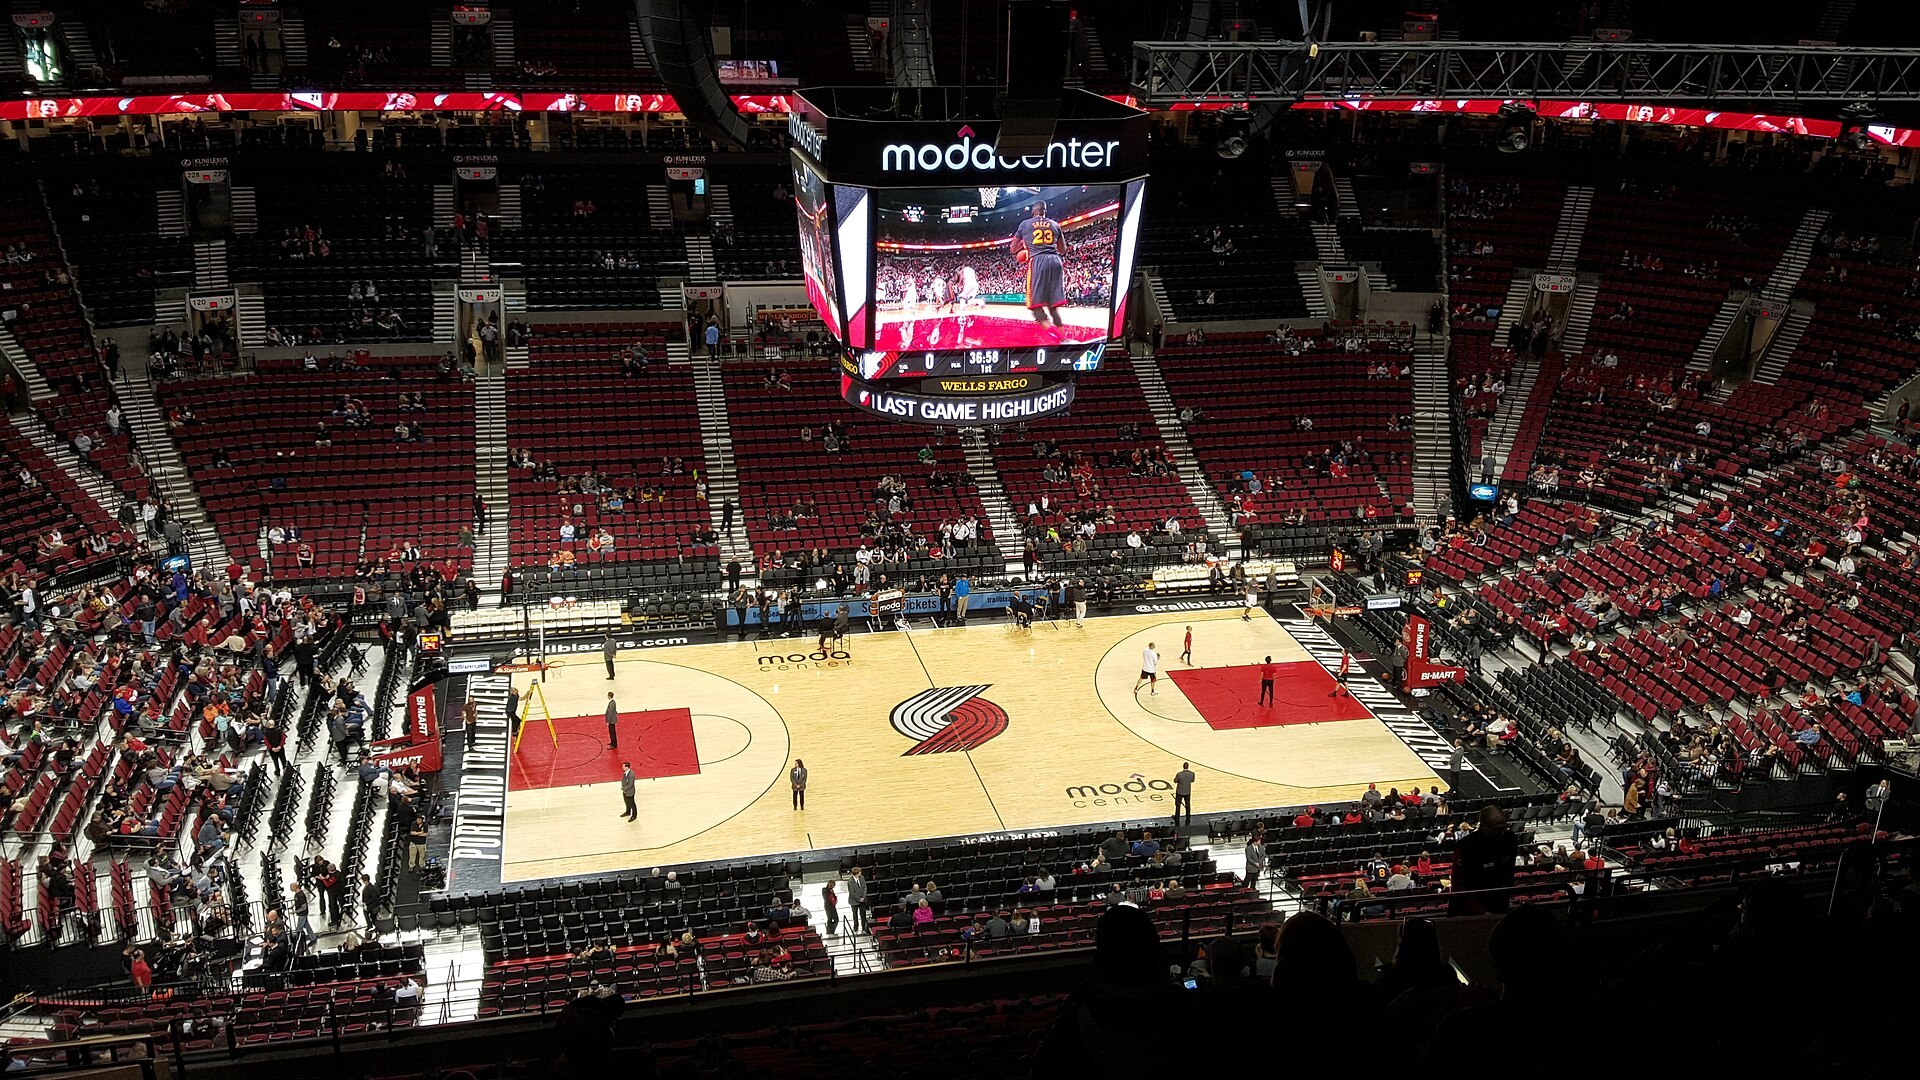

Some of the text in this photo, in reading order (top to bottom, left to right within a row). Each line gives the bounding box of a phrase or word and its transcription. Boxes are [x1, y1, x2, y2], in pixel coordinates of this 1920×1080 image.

[1032, 228, 1054, 245] 23
[486, 290, 499, 298] 122
[1771, 302, 1784, 310] 207
[925, 349, 1046, 370] 0 0
[968, 350, 999, 365] 36:58
[981, 364, 992, 374] 1st
[940, 378, 1028, 392] WELLS FARGO
[877, 388, 1067, 420] LAST GAME HIGHLIGHTS
[880, 602, 901, 612] moda
[905, 599, 937, 612] ickets
[1136, 600, 1247, 613] @trailblazer
[514, 637, 688, 656] trailblazrs.com
[758, 650, 851, 665] moda
[760, 660, 853, 672] center
[1346, 677, 1407, 710] TRAIL
[453, 676, 511, 860] PORTLAND TRAIL BLAZERS
[1066, 777, 1174, 799] moda
[1379, 868, 1386, 878] 8
